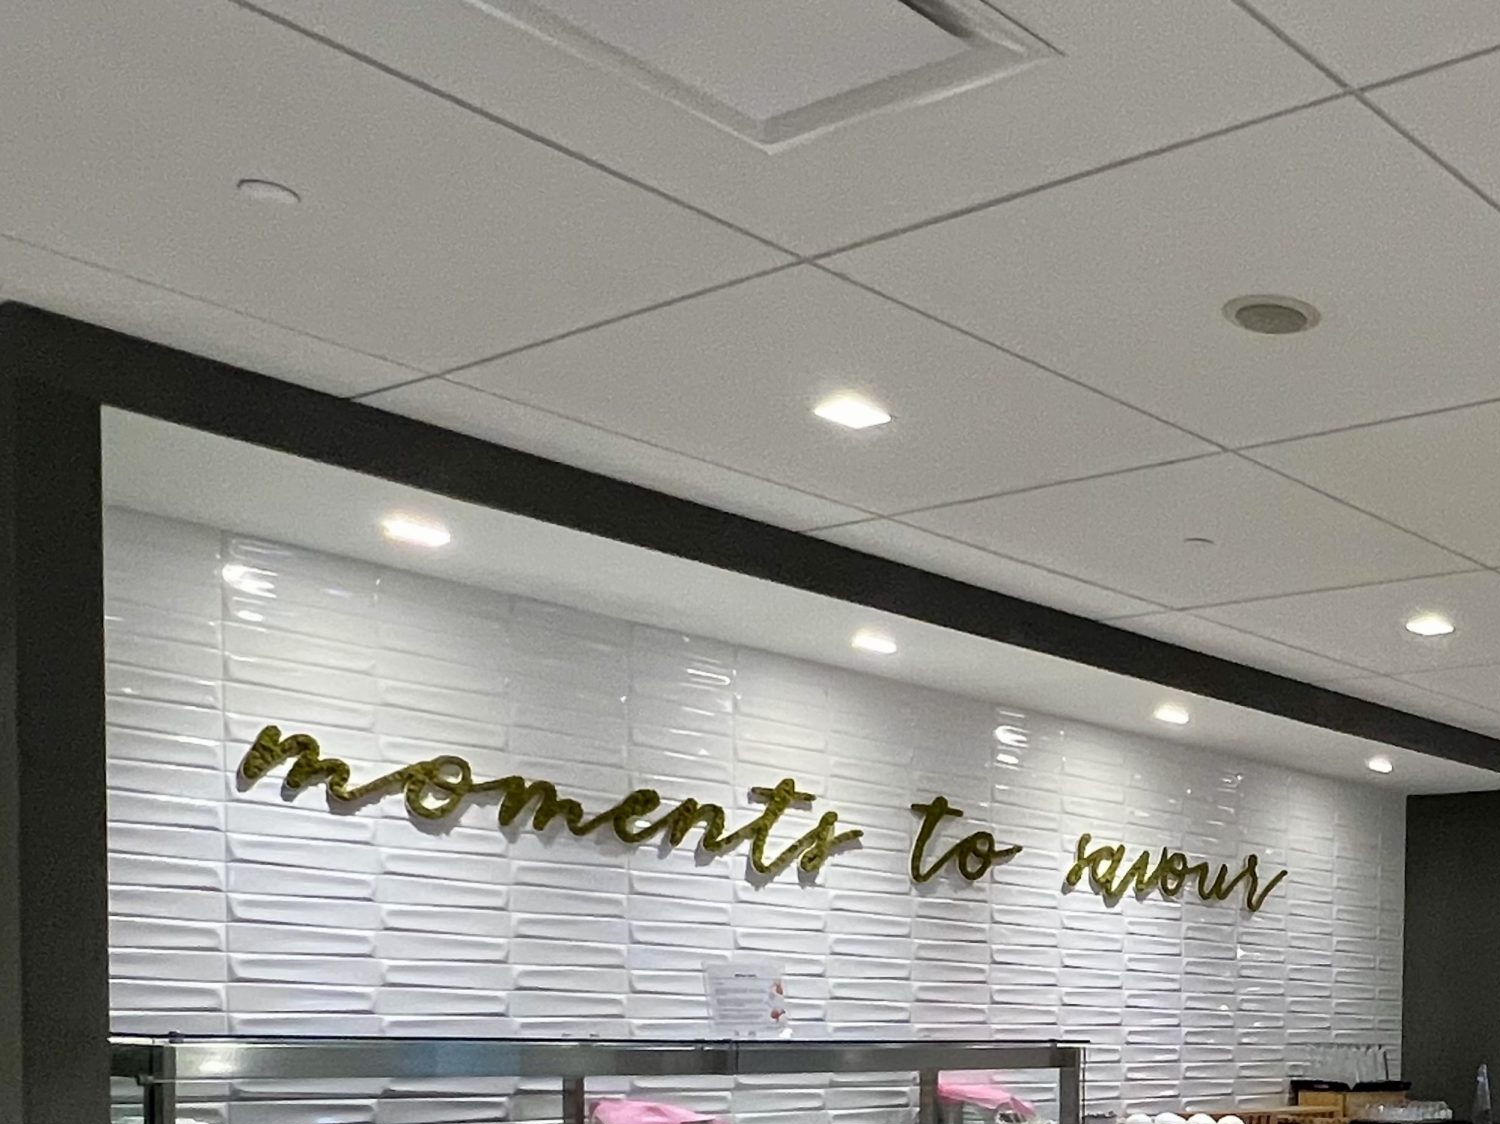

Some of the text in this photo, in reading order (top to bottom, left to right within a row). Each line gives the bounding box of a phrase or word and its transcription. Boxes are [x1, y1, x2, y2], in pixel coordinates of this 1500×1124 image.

[236, 724, 1288, 911] moments to savour
